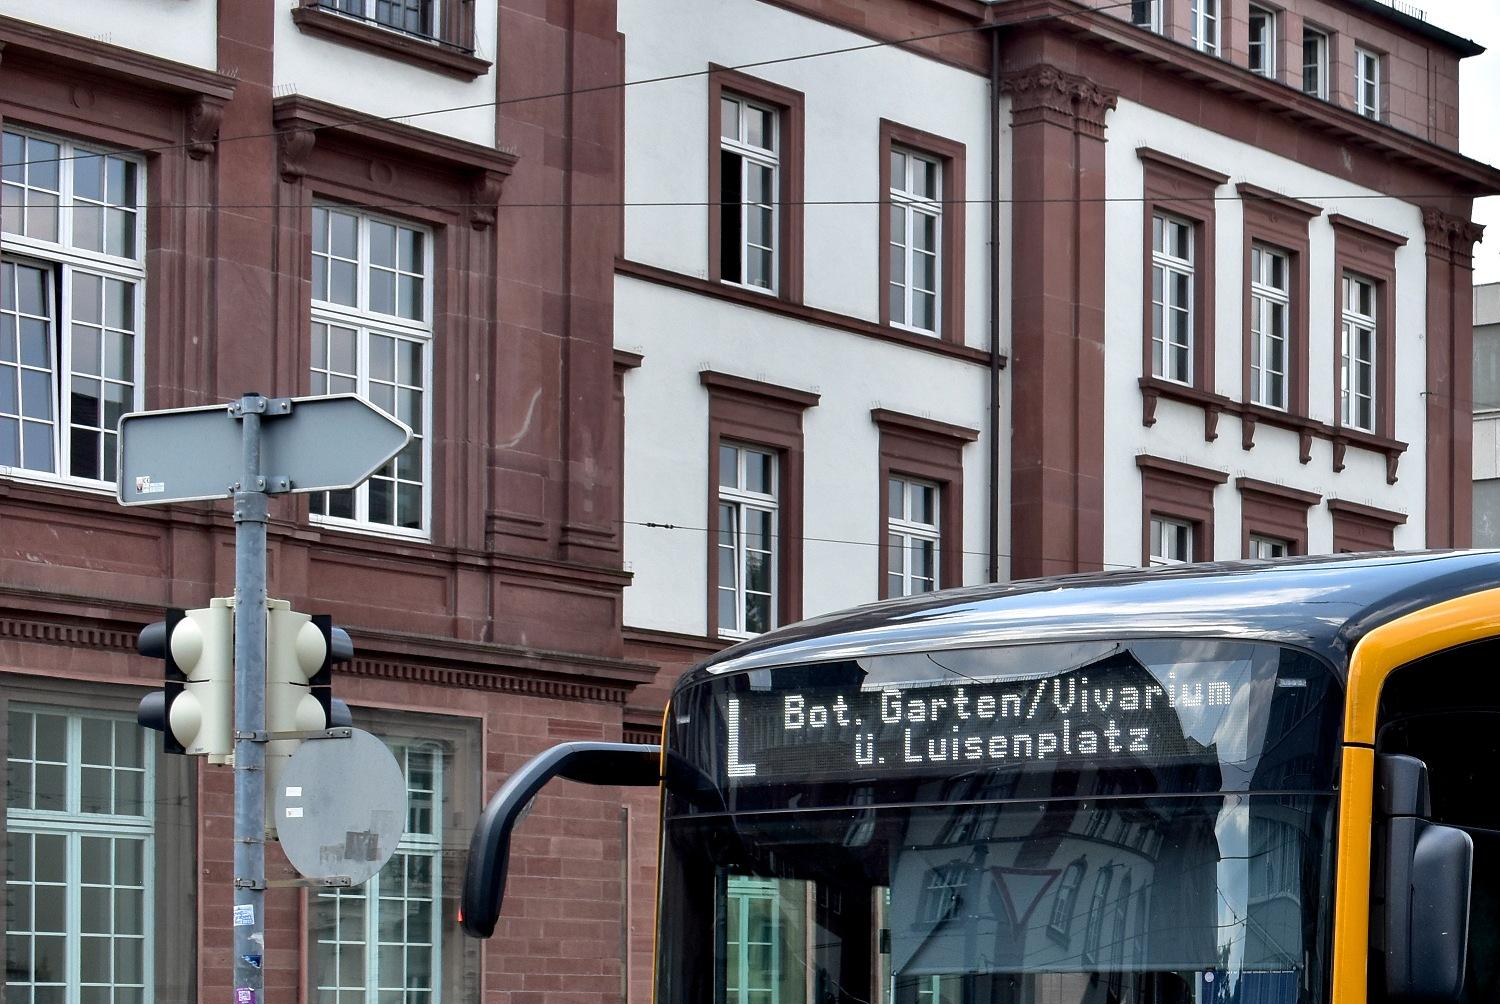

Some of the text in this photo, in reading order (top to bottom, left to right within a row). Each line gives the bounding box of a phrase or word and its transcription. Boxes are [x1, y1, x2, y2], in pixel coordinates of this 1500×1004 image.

[785, 672, 1231, 729] Bot. Garten/Vivarium
[728, 699, 756, 776] L
[856, 720, 1149, 764] ü. Luisenplatz
